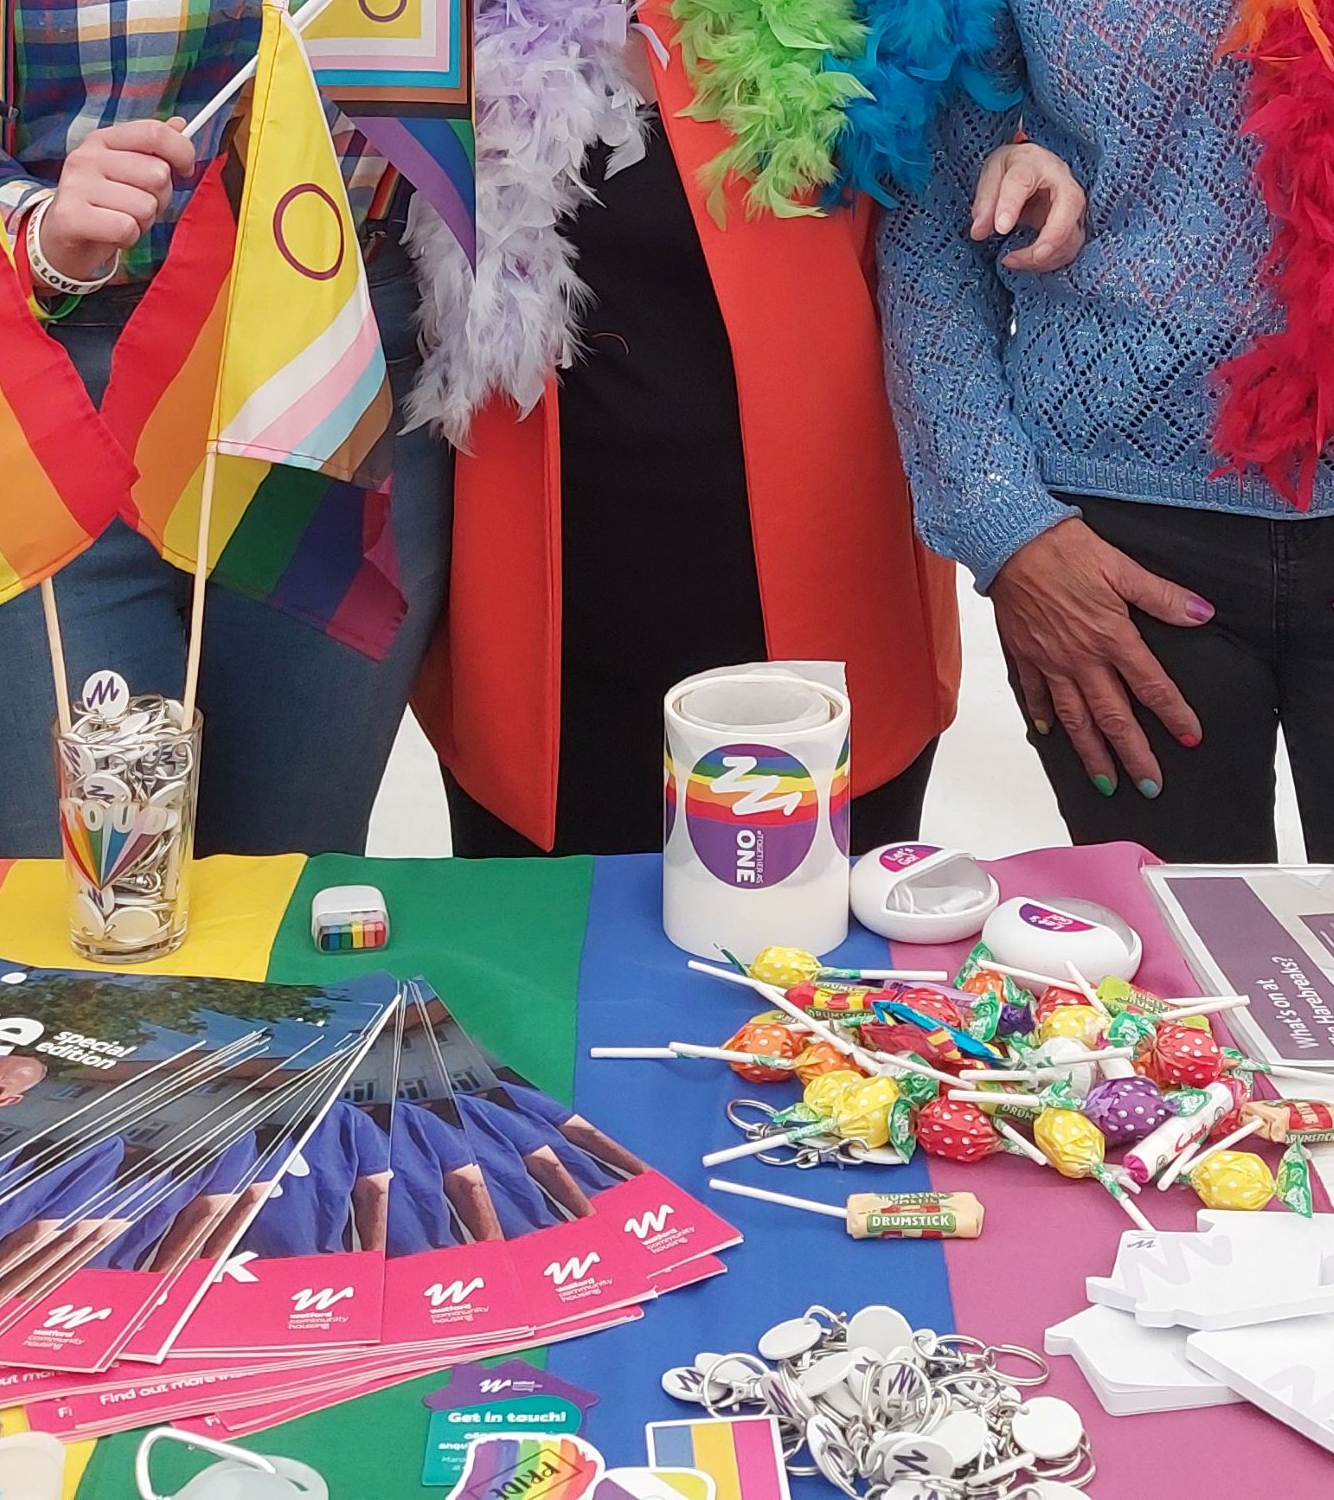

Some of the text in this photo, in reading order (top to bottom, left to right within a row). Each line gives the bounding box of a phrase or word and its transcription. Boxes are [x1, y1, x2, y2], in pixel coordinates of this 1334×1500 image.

[736, 829, 756, 883] ONE
[1255, 978, 1321, 1049] What's on at
[34, 1039, 117, 1071] edition
[53, 1029, 138, 1059] special
[872, 1215, 950, 1227] DRUMSTICK
[100, 1388, 137, 1406] Find
[139, 1384, 169, 1397] out
[171, 1375, 216, 1389] more
[58, 1406, 73, 1418] Fi
[205, 1415, 221, 1427] Fi
[447, 1411, 567, 1423] Get in touch!
